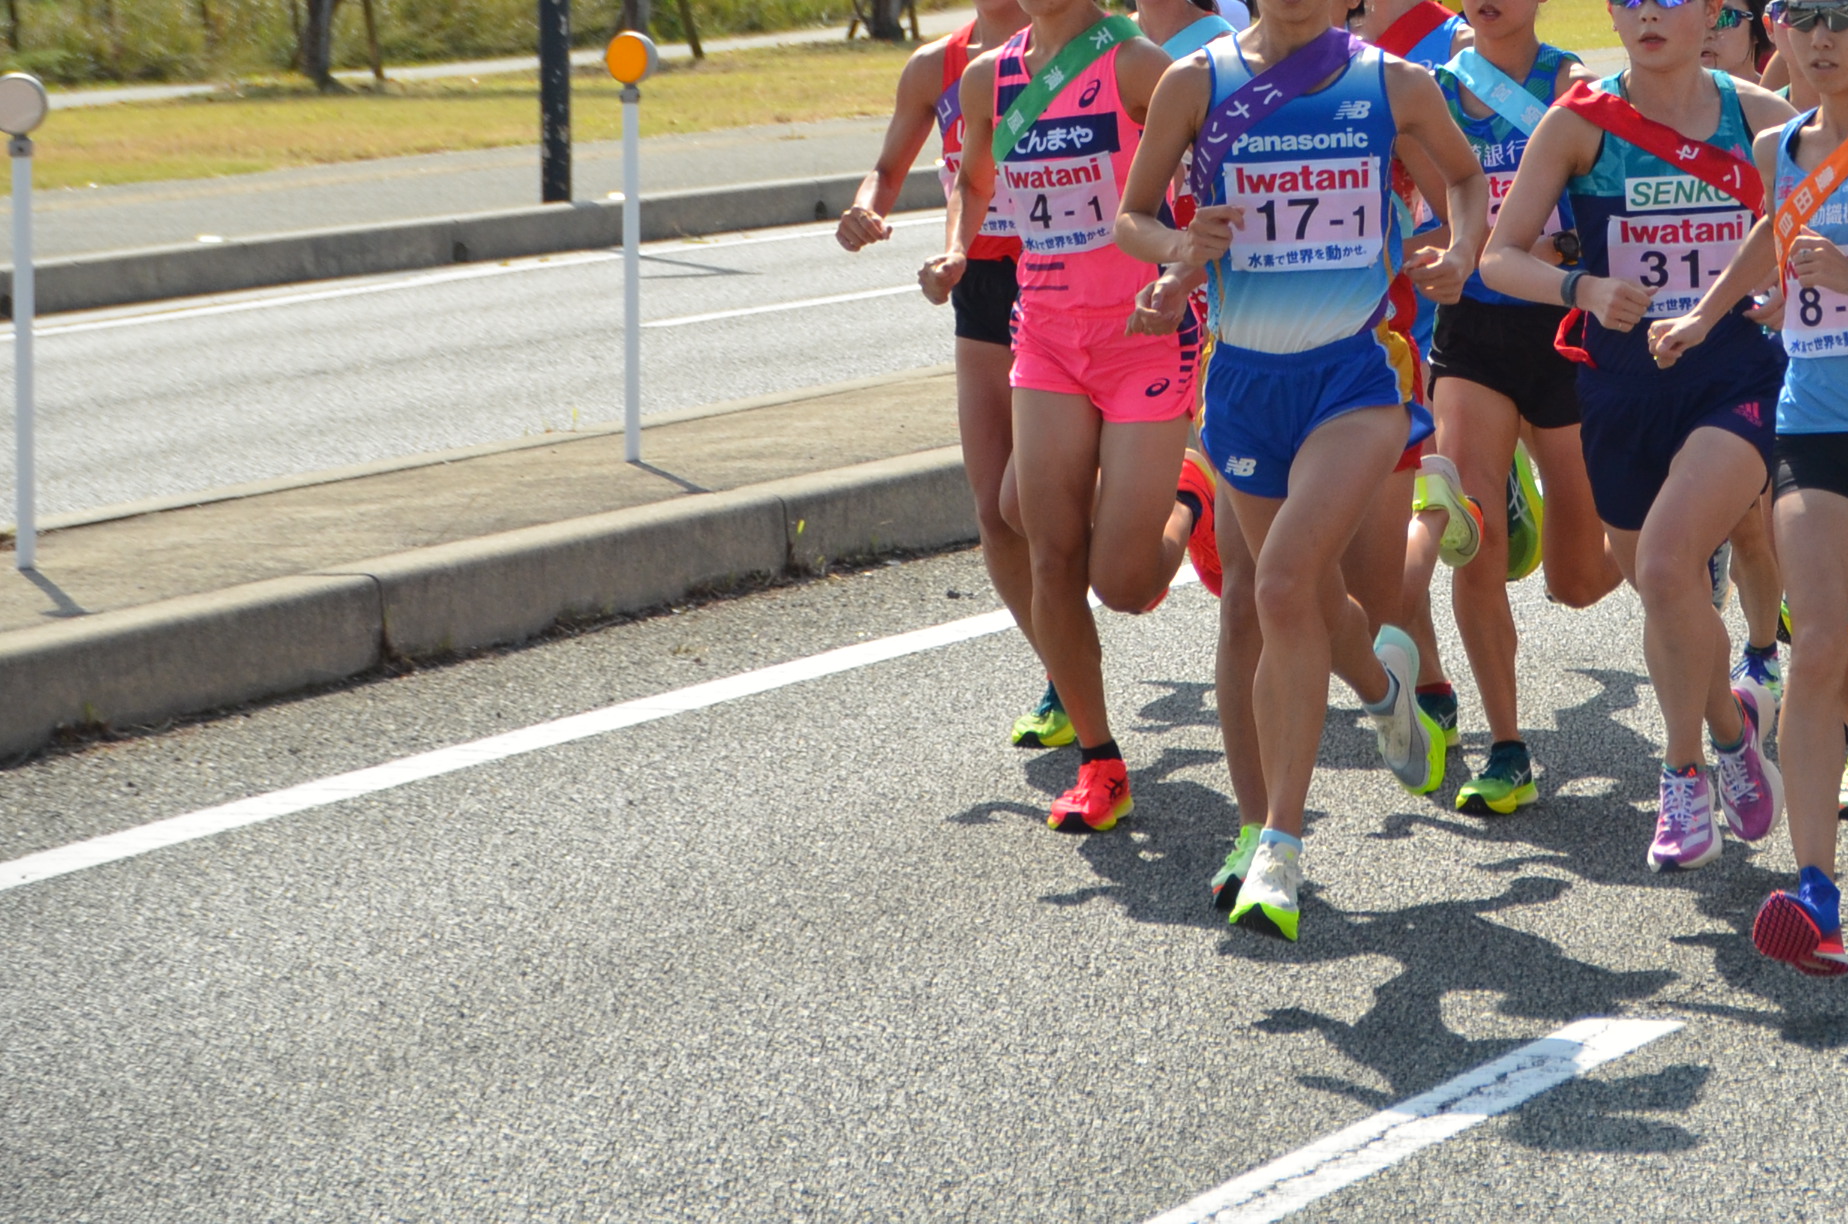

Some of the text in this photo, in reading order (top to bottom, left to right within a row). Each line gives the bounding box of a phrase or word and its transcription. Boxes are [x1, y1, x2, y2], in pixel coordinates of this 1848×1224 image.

[1013, 125, 1095, 155] てんまや
[1231, 127, 1369, 156] Panasonic
[1004, 157, 1103, 190] Iwatani
[1235, 160, 1369, 195] Iwatani
[1029, 193, 1104, 230] 4-1
[1256, 197, 1366, 242] 17-1
[1620, 214, 1744, 244] Iwatani
[1247, 243, 1368, 269] 水素で世界を動かせ。
[1639, 249, 1722, 289] 31-
